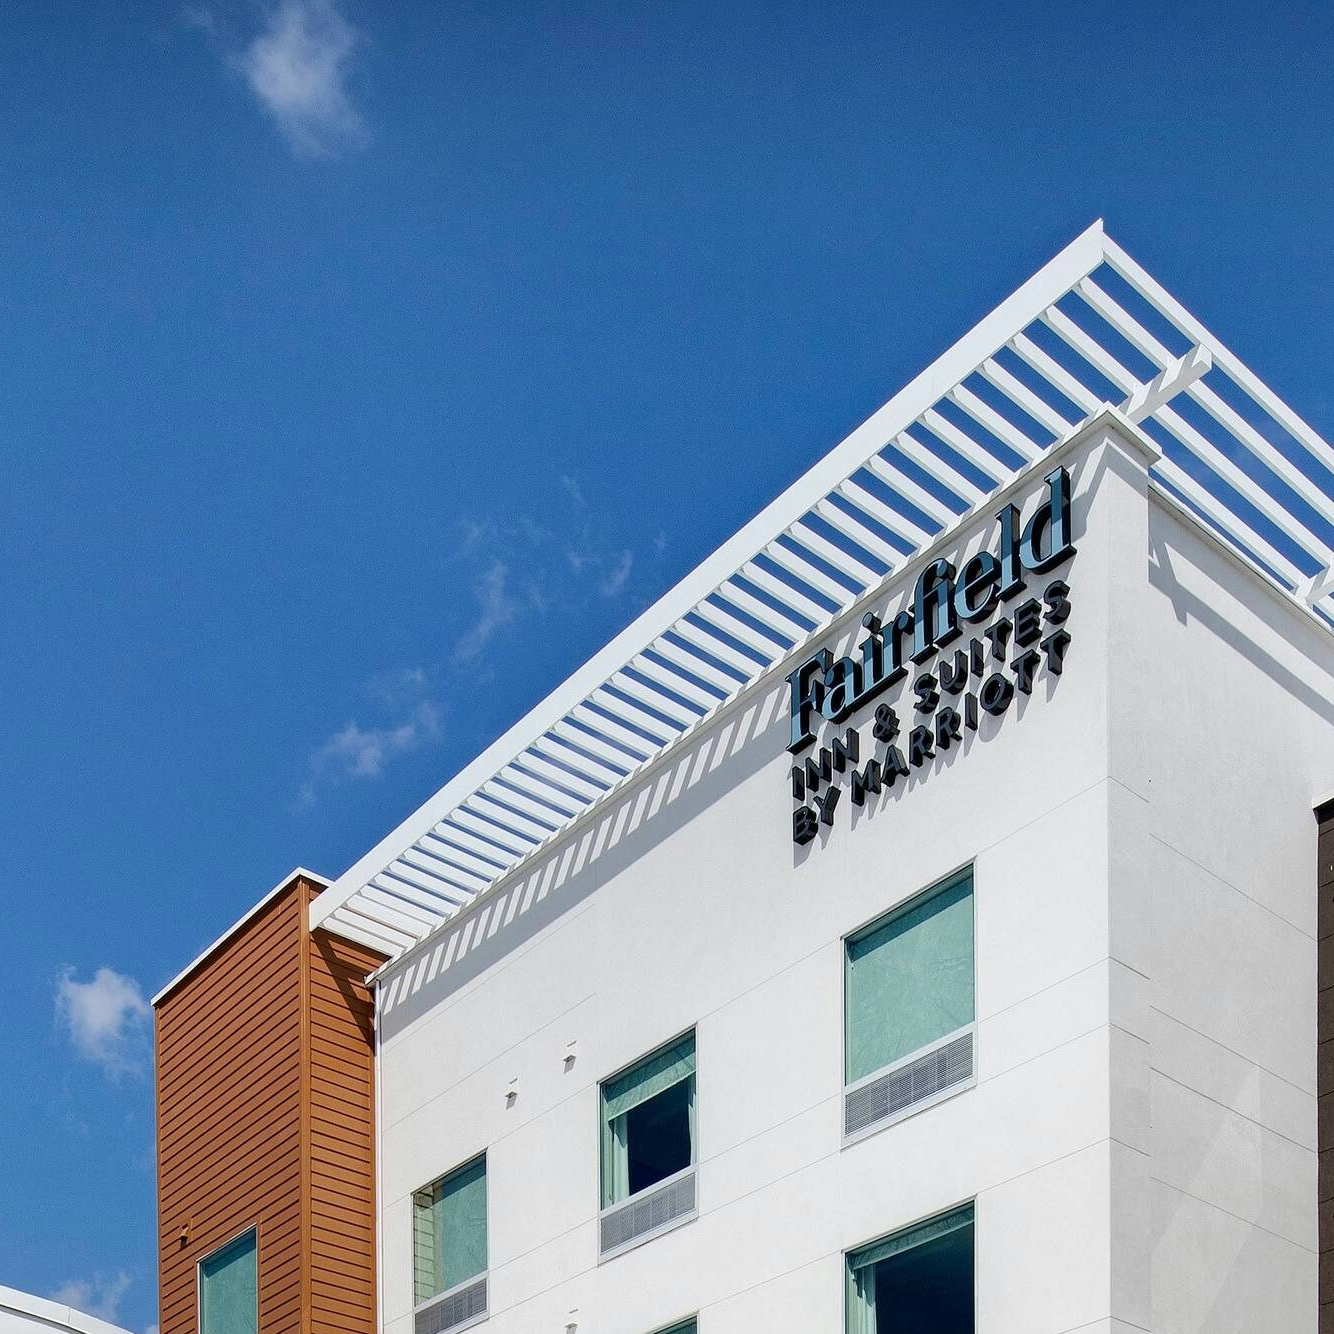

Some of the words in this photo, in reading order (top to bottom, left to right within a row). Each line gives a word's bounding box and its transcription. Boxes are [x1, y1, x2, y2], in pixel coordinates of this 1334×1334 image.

[786, 465, 1077, 755] Fairfield
[792, 727, 859, 801] INN
[873, 703, 901, 745] &
[913, 580, 1072, 714] SUITES
[792, 785, 841, 846] BY
[851, 629, 1072, 807] MARRIOTT
